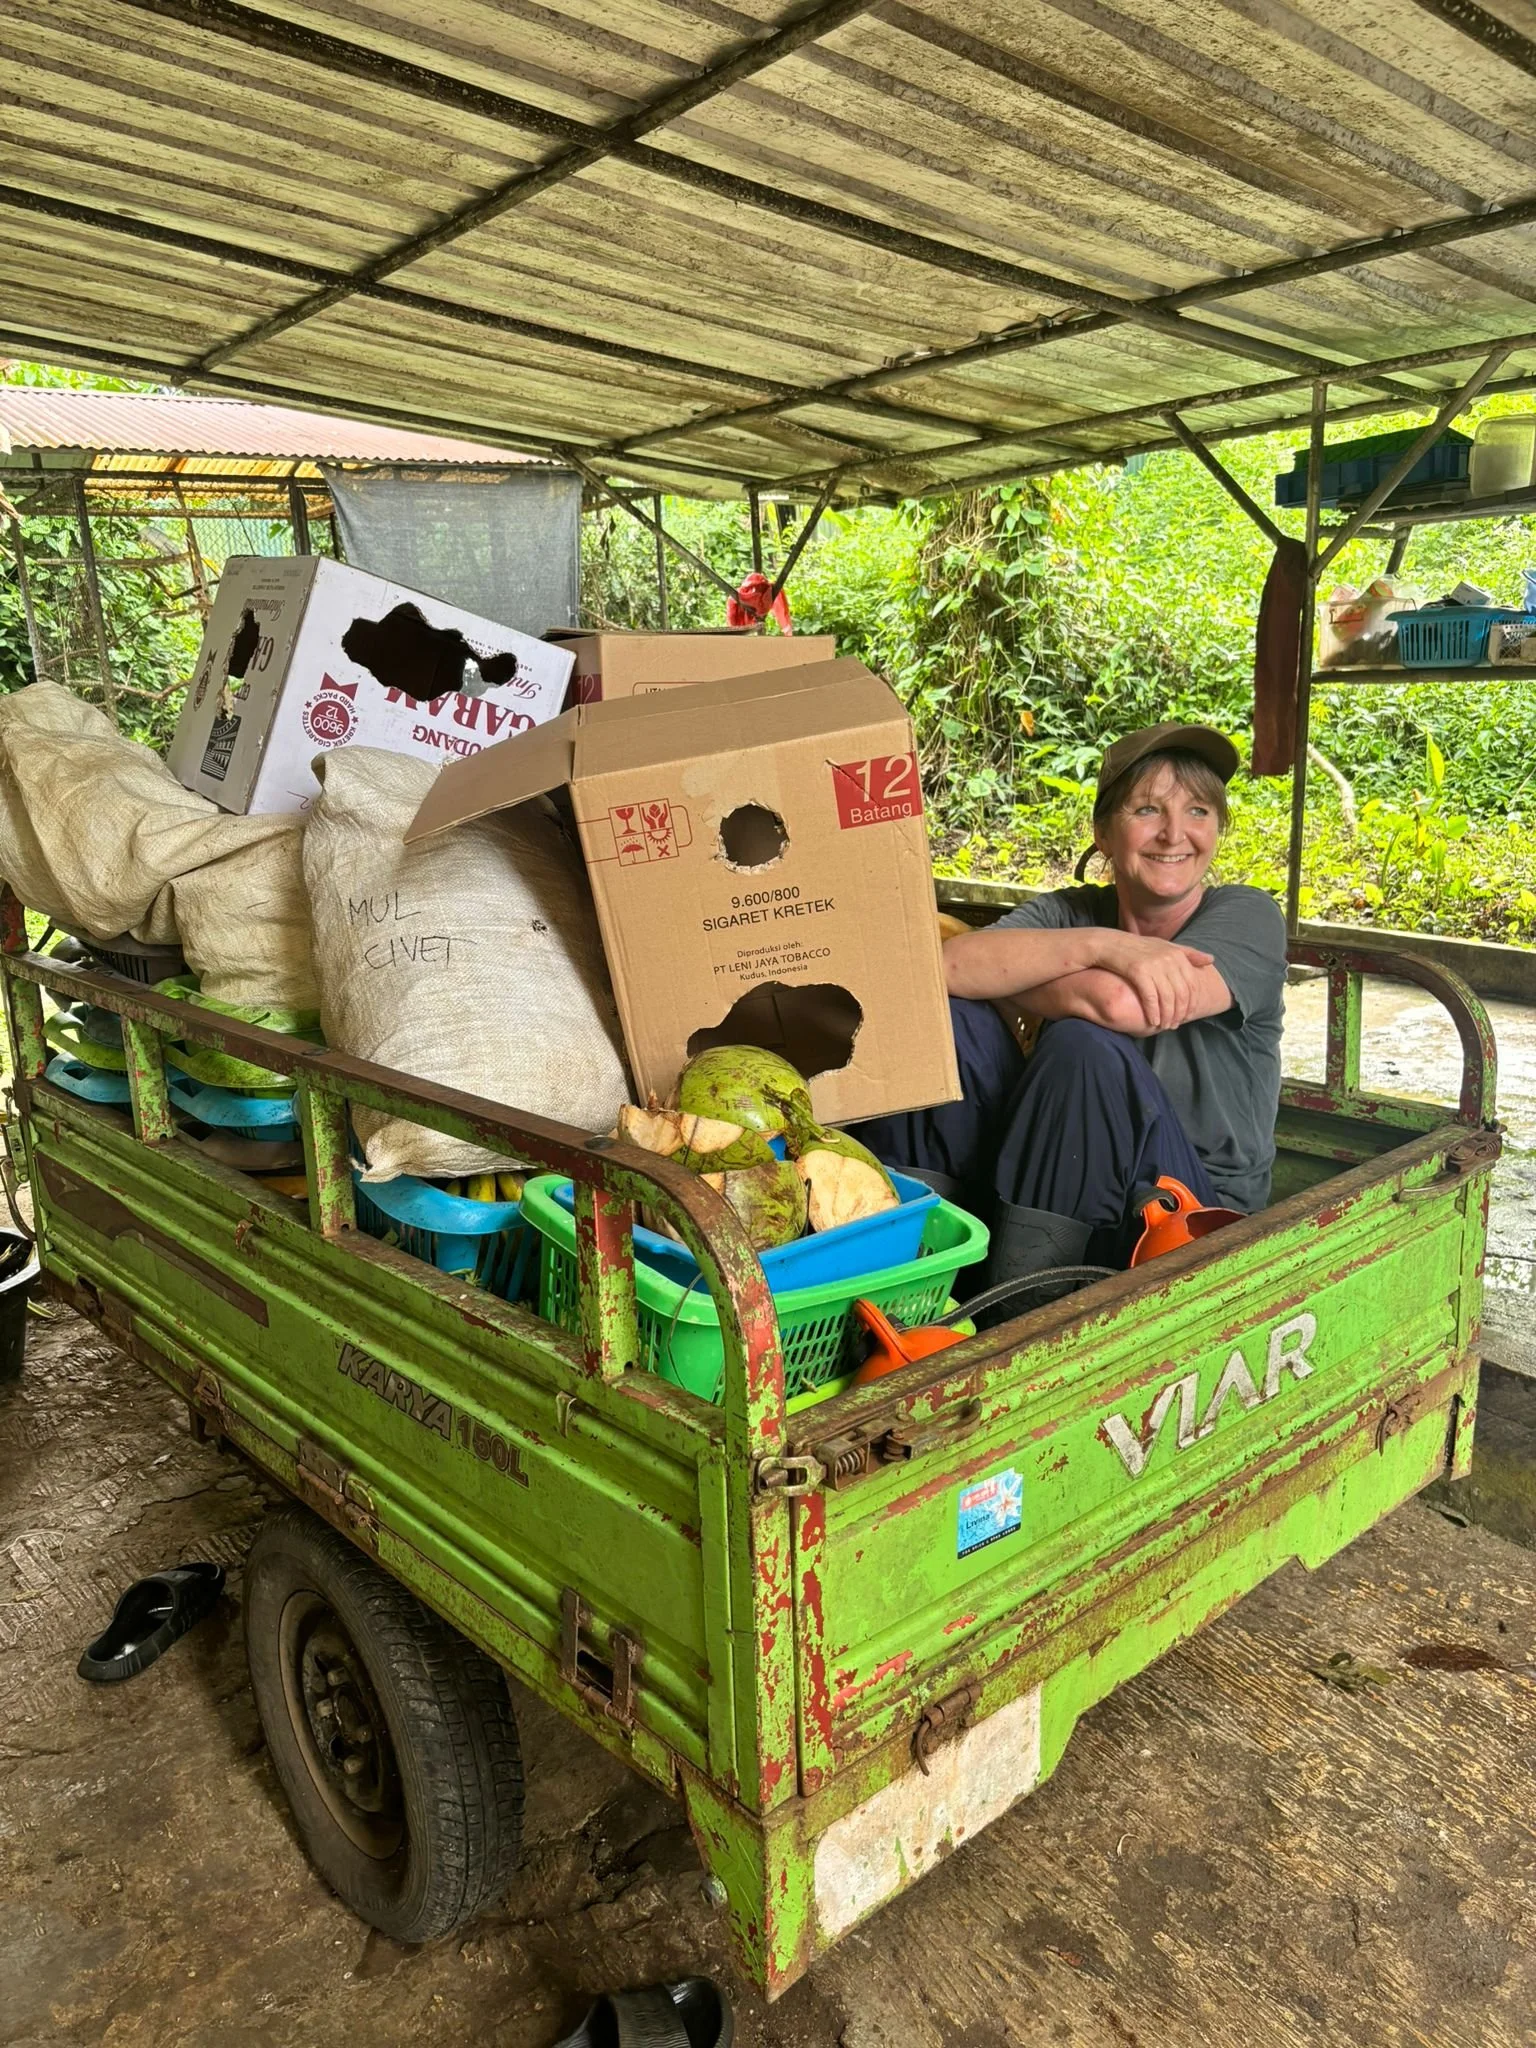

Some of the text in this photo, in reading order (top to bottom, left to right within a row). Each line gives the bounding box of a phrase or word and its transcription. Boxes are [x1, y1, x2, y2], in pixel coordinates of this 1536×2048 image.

[313, 692, 356, 714] HARD PACKS
[577, 674, 595, 703] 12
[313, 716, 344, 735] 9600
[325, 705, 338, 719] 12
[302, 711, 356, 748] KRETEK CIGARETTES
[412, 724, 487, 757] UDANG
[856, 753, 913, 802] 12
[850, 802, 912, 824] Batang
[349, 891, 421, 926] MUL
[731, 886, 800, 909] 9.600/800
[702, 897, 836, 932] SIGARET KRETEK
[364, 935, 478, 970] CIVET
[713, 947, 831, 975] PT LENI JAYA TOBACCO
[737, 941, 804, 958] Diproduksi oleh:
[740, 964, 808, 981] Kudus, Indonesia
[1101, 1311, 1318, 1478] VIAR
[337, 1342, 530, 1488] KARYA 150L
